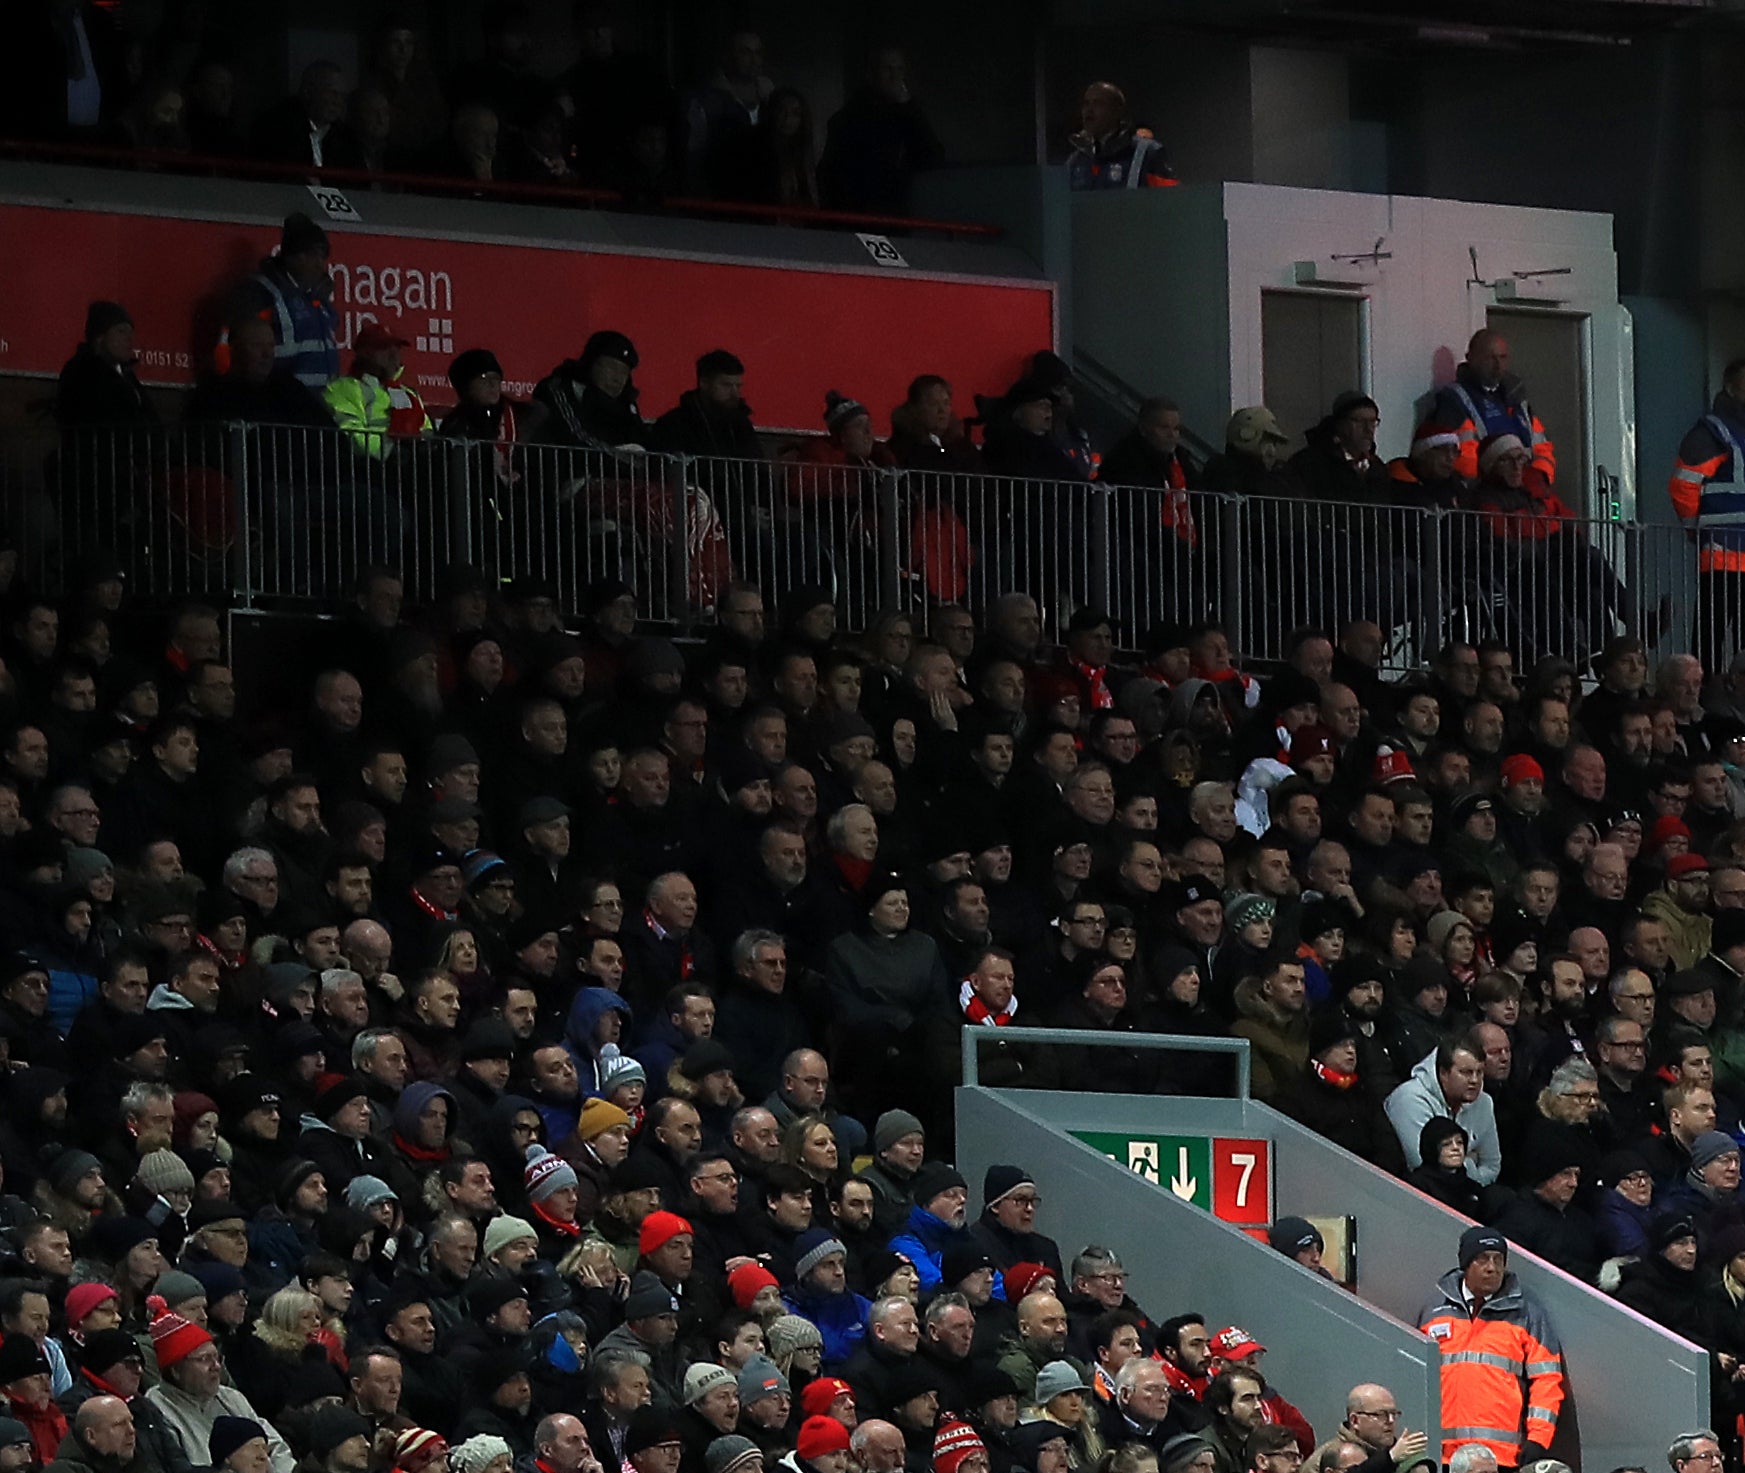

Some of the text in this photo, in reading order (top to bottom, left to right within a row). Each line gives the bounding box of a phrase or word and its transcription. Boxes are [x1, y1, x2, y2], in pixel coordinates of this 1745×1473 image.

[317, 193, 352, 213] 28
[866, 240, 900, 261] 29
[1230, 1153, 1256, 1207] 7
